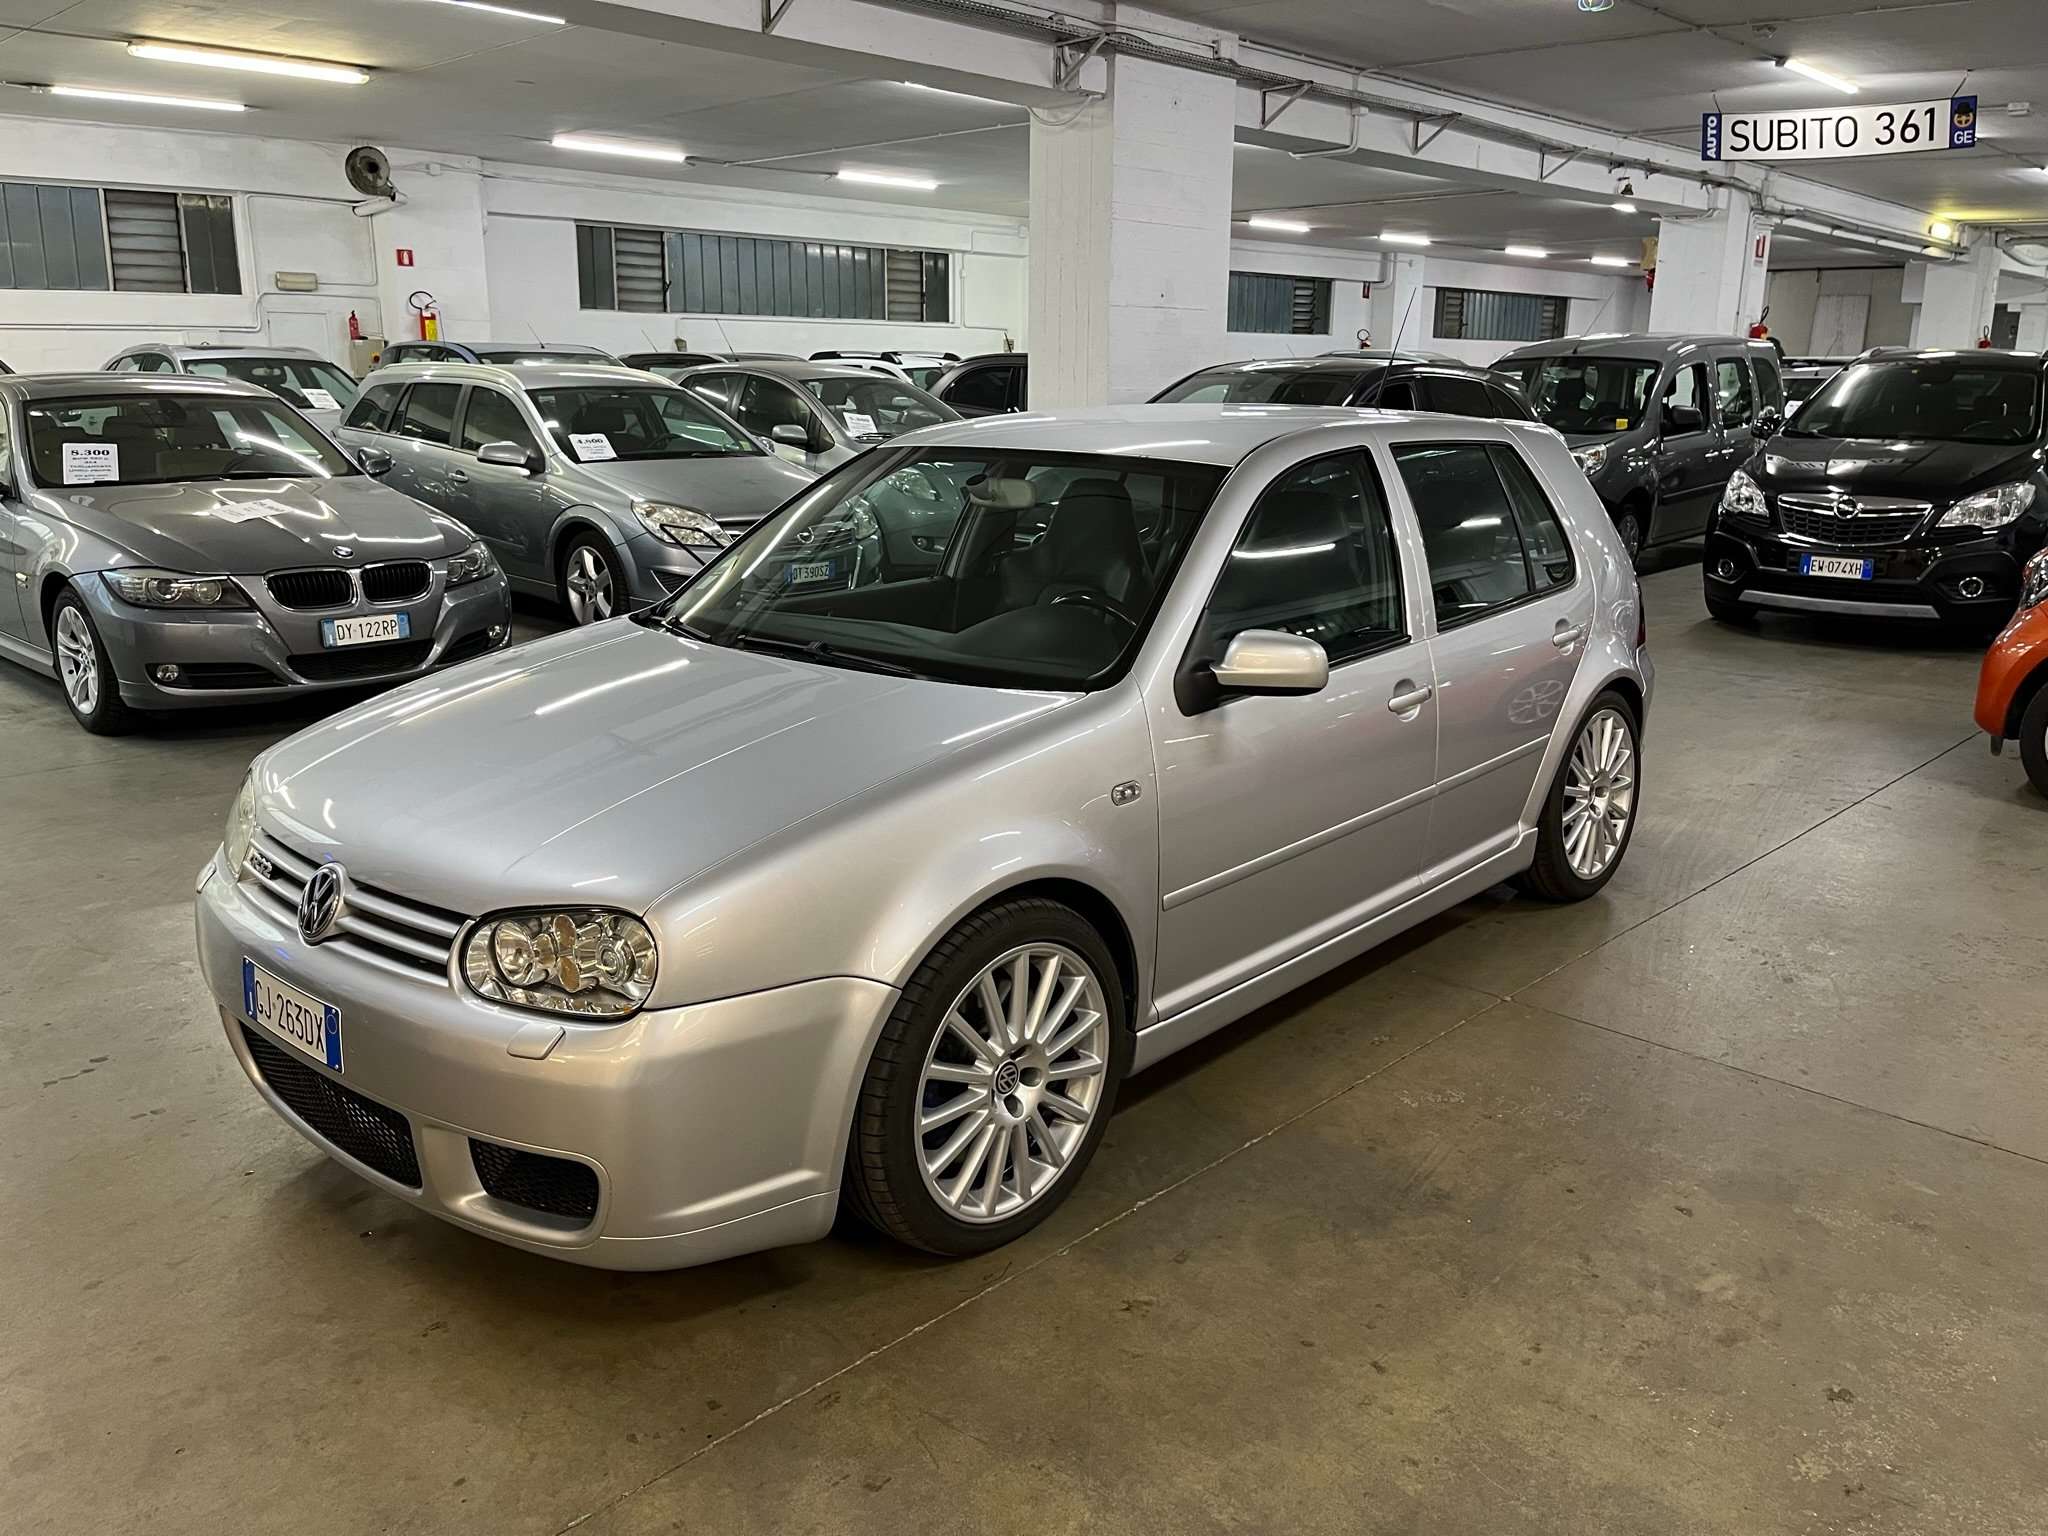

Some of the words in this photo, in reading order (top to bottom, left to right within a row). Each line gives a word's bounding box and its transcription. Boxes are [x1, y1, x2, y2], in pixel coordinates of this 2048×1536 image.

[1706, 115, 1717, 159] AUTO
[1729, 115, 1858, 153] SUBITO
[1874, 107, 1936, 146] 361
[1953, 129, 1973, 145] GE
[336, 623, 352, 641] DY
[358, 619, 397, 639] 122RP
[255, 979, 273, 1020] GJ
[276, 993, 325, 1053] 263DX
